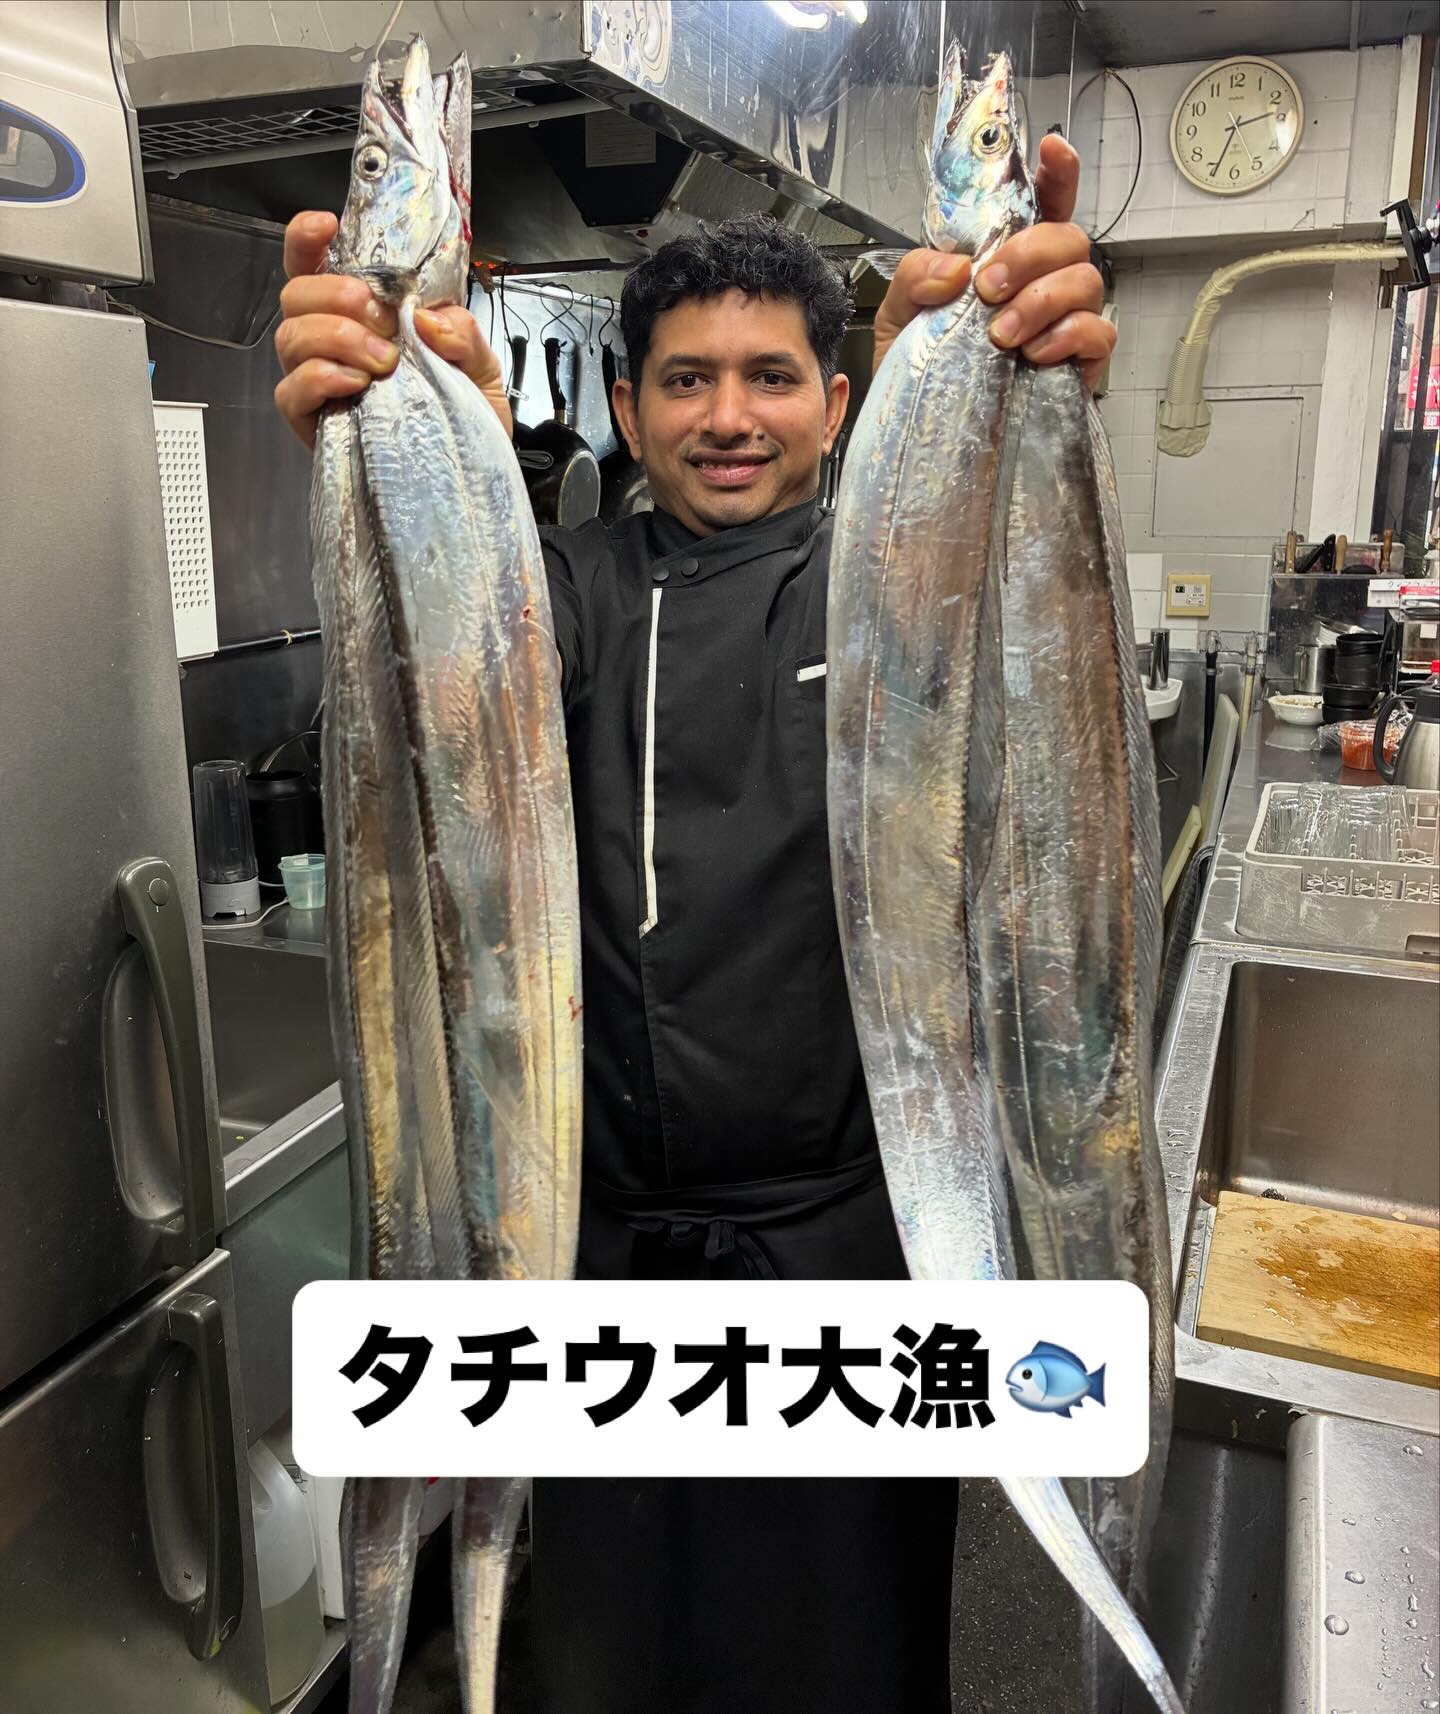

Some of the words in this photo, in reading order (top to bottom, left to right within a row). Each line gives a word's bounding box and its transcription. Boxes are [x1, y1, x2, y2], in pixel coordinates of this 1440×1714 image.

[1230, 72, 1246, 89] 12
[1258, 76, 1263, 91] 1
[1210, 82, 1220, 98] 11
[1270, 90, 1282, 105] 2
[1191, 101, 1206, 117] 10
[1186, 125, 1198, 140] 9
[1191, 147, 1203, 162] 8
[1206, 162, 1219, 177] 7
[1251, 156, 1263, 171] 5
[1229, 164, 1240, 180] 6
